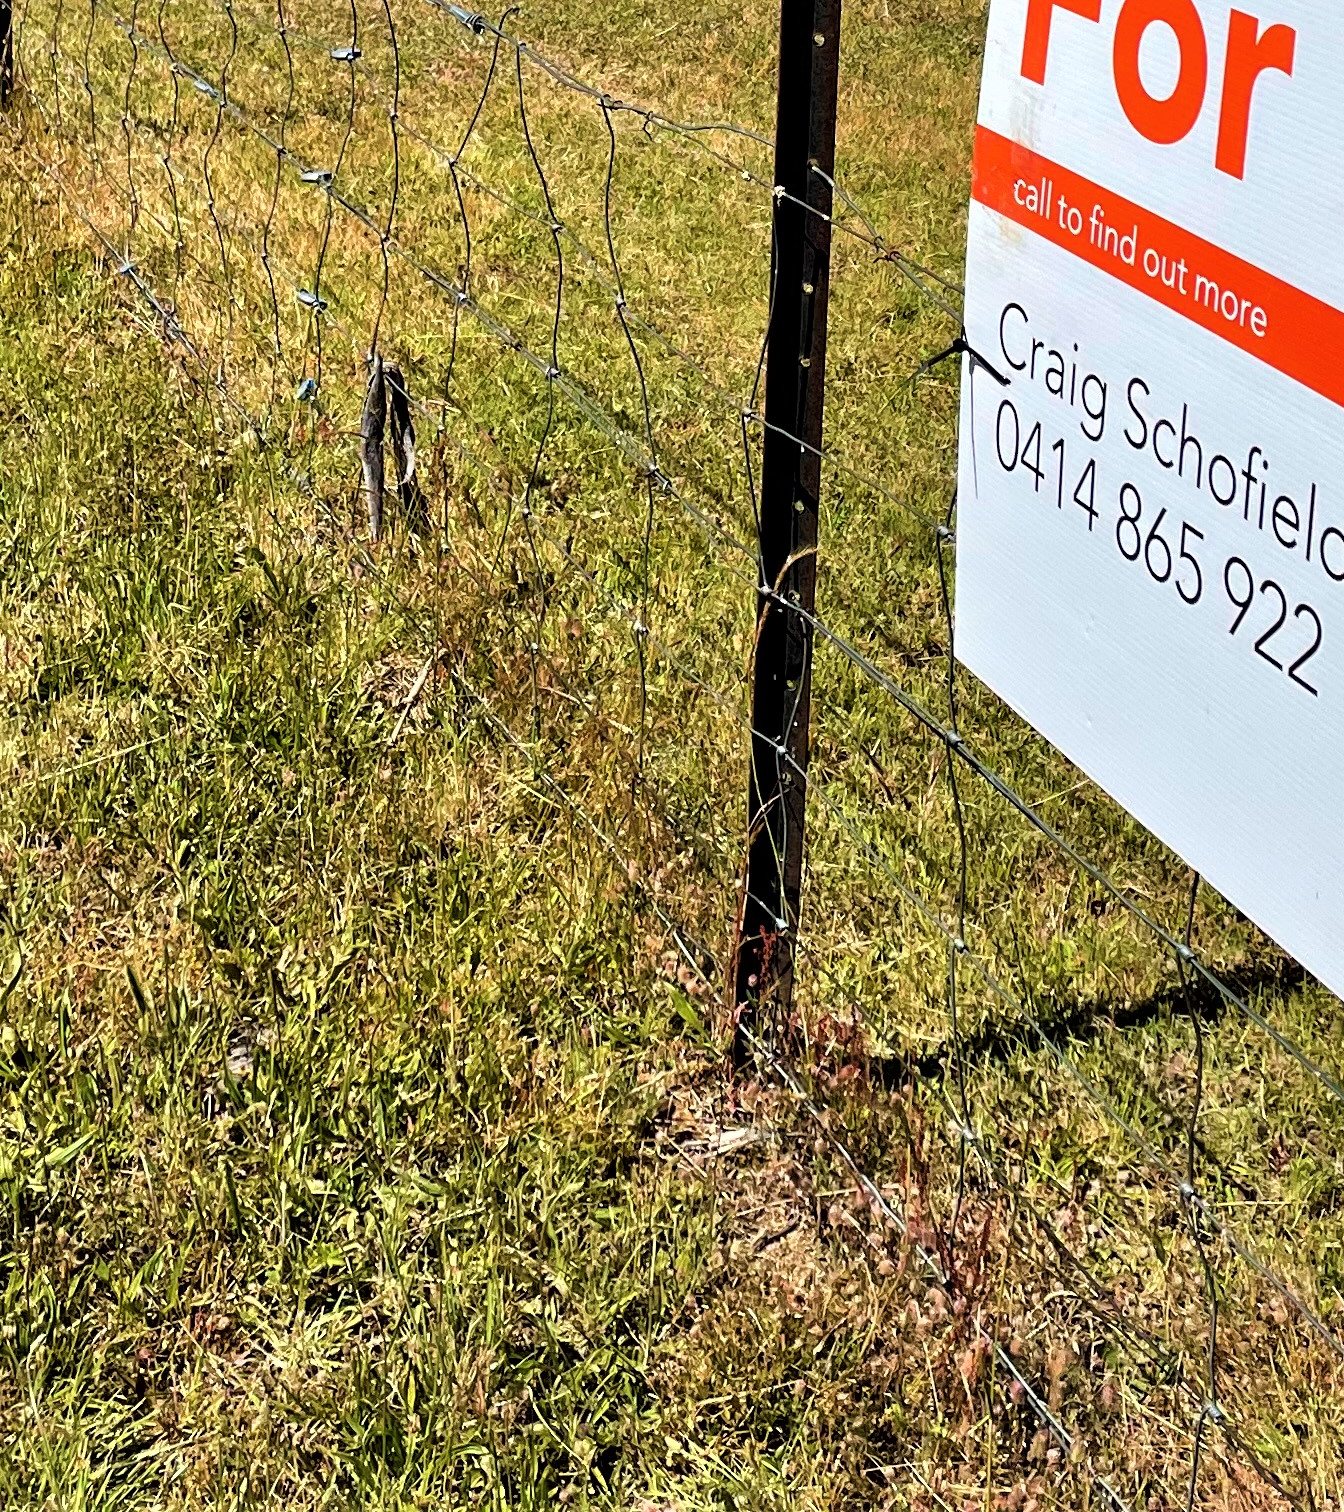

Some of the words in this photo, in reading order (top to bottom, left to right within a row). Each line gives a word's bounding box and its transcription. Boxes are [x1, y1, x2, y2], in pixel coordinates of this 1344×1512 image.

[1014, 177, 1052, 218] call
[1058, 194, 1082, 236] to
[1089, 205, 1137, 266] find
[1143, 248, 1188, 295] out
[1195, 273, 1268, 338] more
[999, 302, 1107, 441] Craig
[995, 399, 1099, 532] 0414
[1116, 482, 1204, 605] 865
[1224, 556, 1323, 696] 922
